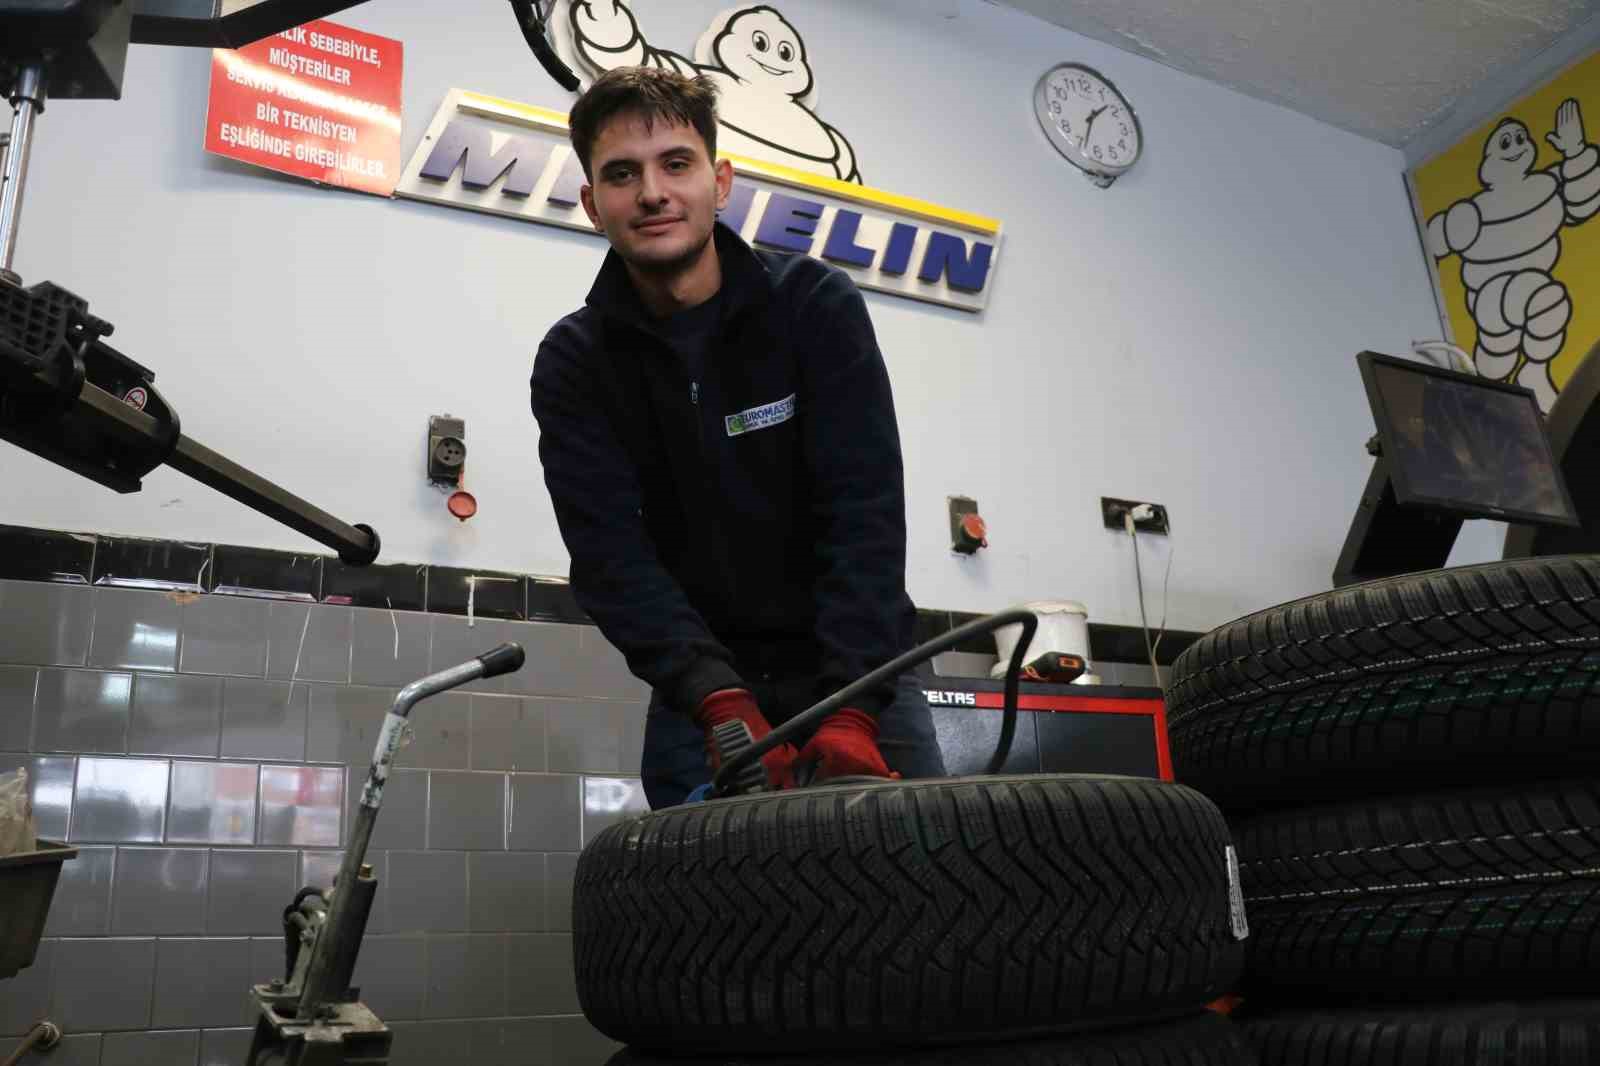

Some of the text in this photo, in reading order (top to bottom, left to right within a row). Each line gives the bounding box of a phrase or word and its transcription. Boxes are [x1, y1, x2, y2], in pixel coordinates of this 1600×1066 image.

[269, 47, 351, 86] MÜŞTERİLER
[310, 31, 381, 69] SEBEBİYLE,
[220, 122, 291, 158] EŞLİĞİNDE
[256, 101, 357, 144] BİR TEKNİSYEN
